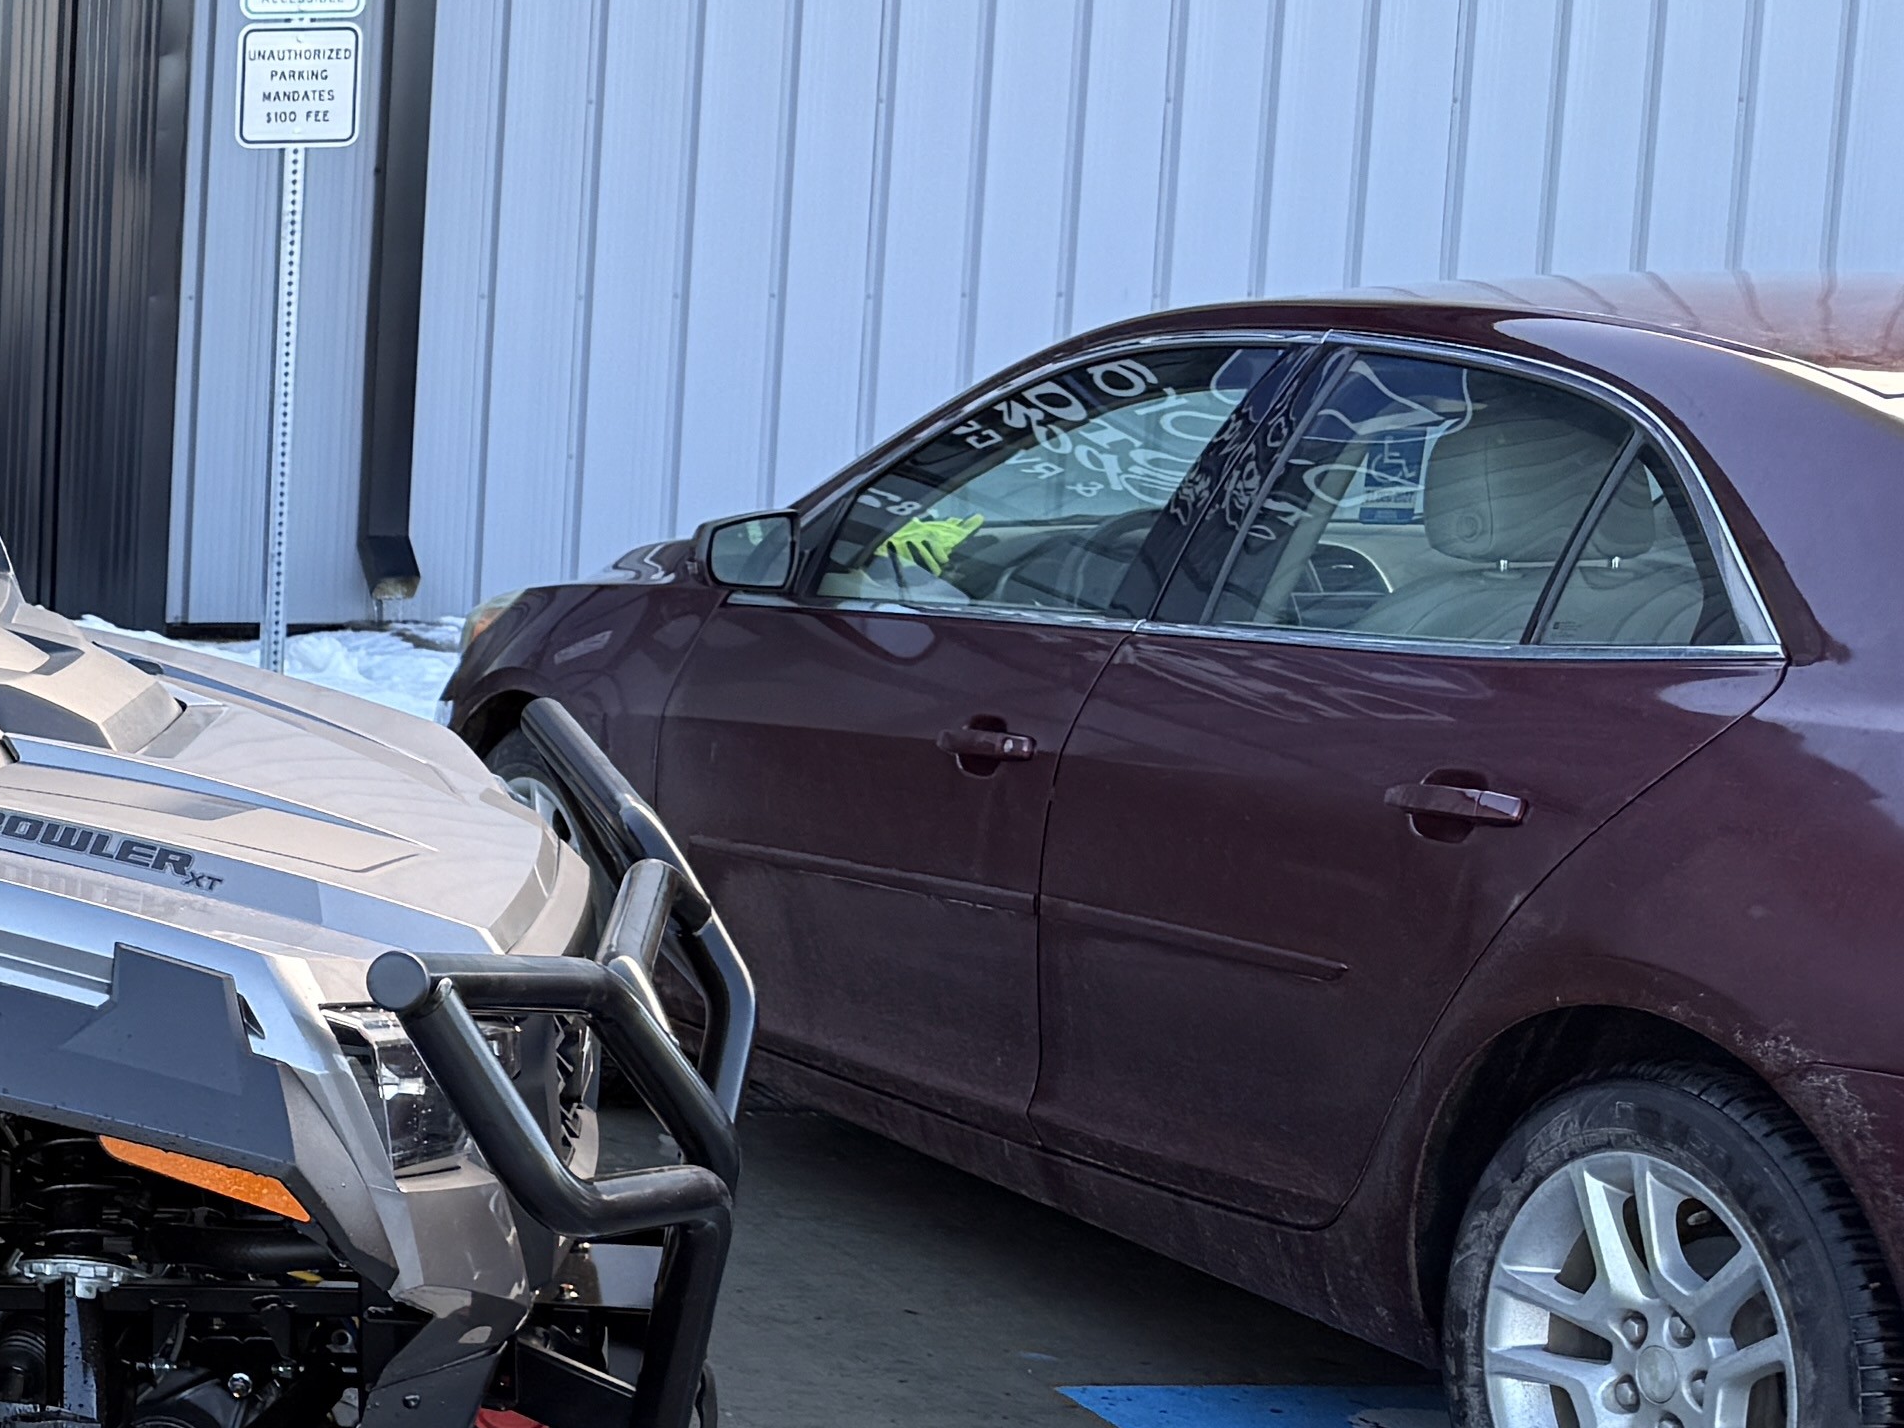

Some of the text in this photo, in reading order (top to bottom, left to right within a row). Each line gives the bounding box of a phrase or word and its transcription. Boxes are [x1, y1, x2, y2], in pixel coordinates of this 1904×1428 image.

[248, 48, 352, 61] UNAUTHORIZED
[270, 69, 329, 82] PARKING
[262, 90, 335, 102] MANDATES
[265, 111, 330, 123] $100 FEE
[180, 872, 223, 892] XT
